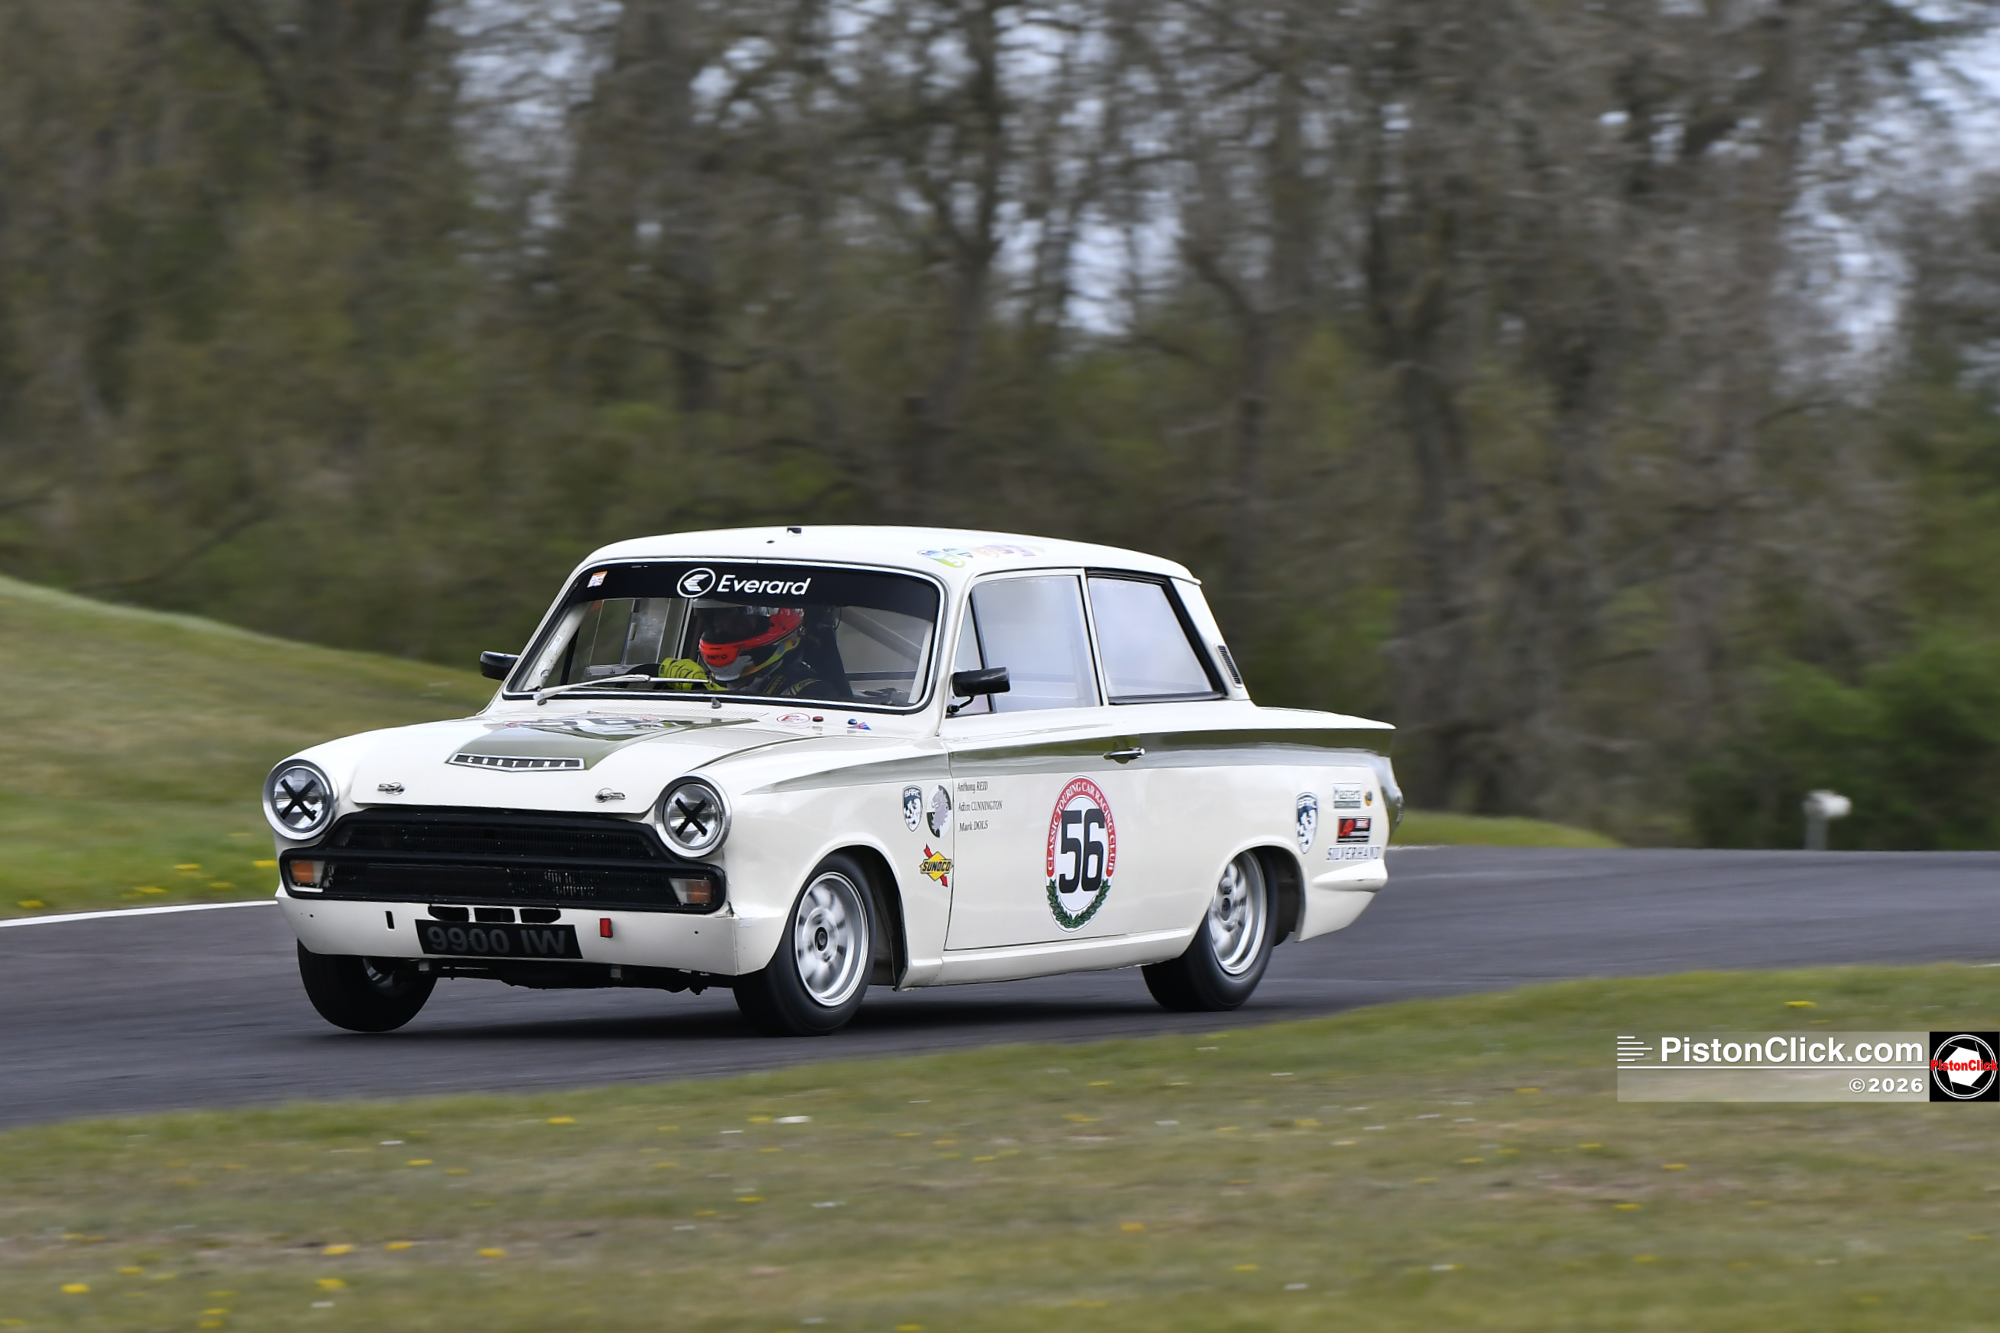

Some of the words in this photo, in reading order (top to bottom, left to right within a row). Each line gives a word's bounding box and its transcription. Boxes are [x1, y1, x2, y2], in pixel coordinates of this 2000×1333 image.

[716, 573, 812, 596] Everard
[467, 757, 566, 768] CORTINA
[959, 822, 973, 832] Mark
[973, 820, 989, 831] DOLS
[1047, 815, 1060, 871] CLASSIC
[1056, 782, 1082, 813] TOURING
[1081, 781, 1096, 797] CAR
[1095, 790, 1114, 831] RACING
[1108, 832, 1116, 871] CLUB
[1058, 808, 1106, 894] 56
[922, 860, 952, 872] SUNOCO
[426, 926, 510, 954] 9900
[520, 929, 566, 954] IW
